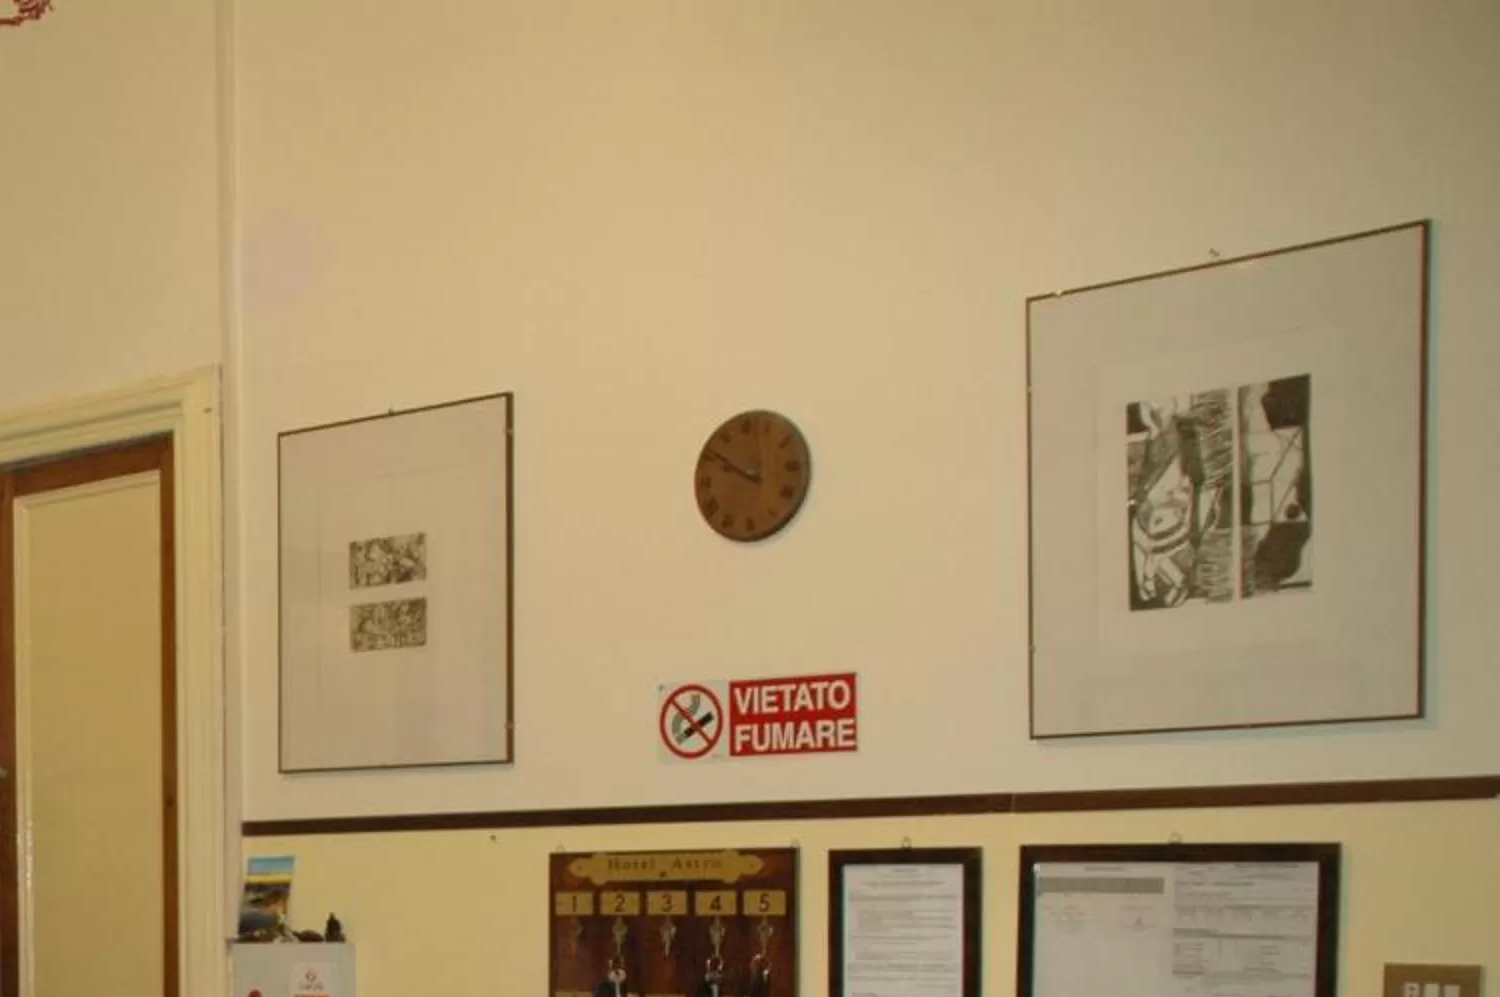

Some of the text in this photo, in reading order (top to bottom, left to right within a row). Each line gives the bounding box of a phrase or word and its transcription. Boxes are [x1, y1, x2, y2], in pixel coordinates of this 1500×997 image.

[733, 680, 850, 715] VIETATO
[734, 718, 855, 753] FUMARE
[614, 894, 626, 913] 2
[660, 894, 674, 913] 3
[708, 894, 722, 912] 4
[758, 893, 771, 912] 5
